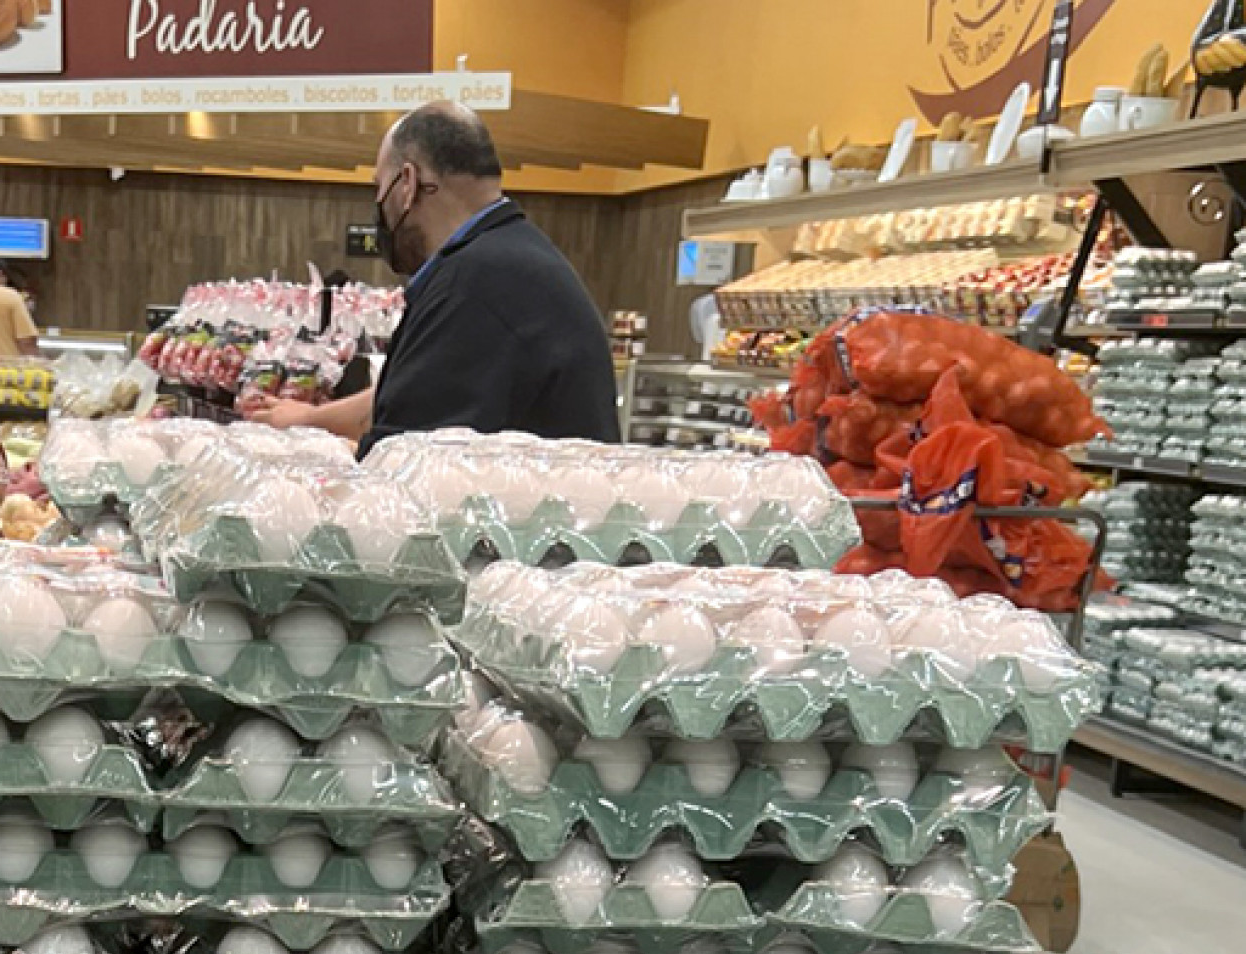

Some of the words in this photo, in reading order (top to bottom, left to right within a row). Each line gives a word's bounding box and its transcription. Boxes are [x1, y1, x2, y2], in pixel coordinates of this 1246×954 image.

[127, 0, 324, 60] Padaria
[38, 88, 80, 107] tortas
[92, 85, 128, 108] pães
[142, 86, 181, 105] bolos
[194, 85, 288, 104] rocamboles
[303, 83, 379, 103] biscoitos
[392, 83, 445, 101] tortas
[460, 80, 505, 104] pães
